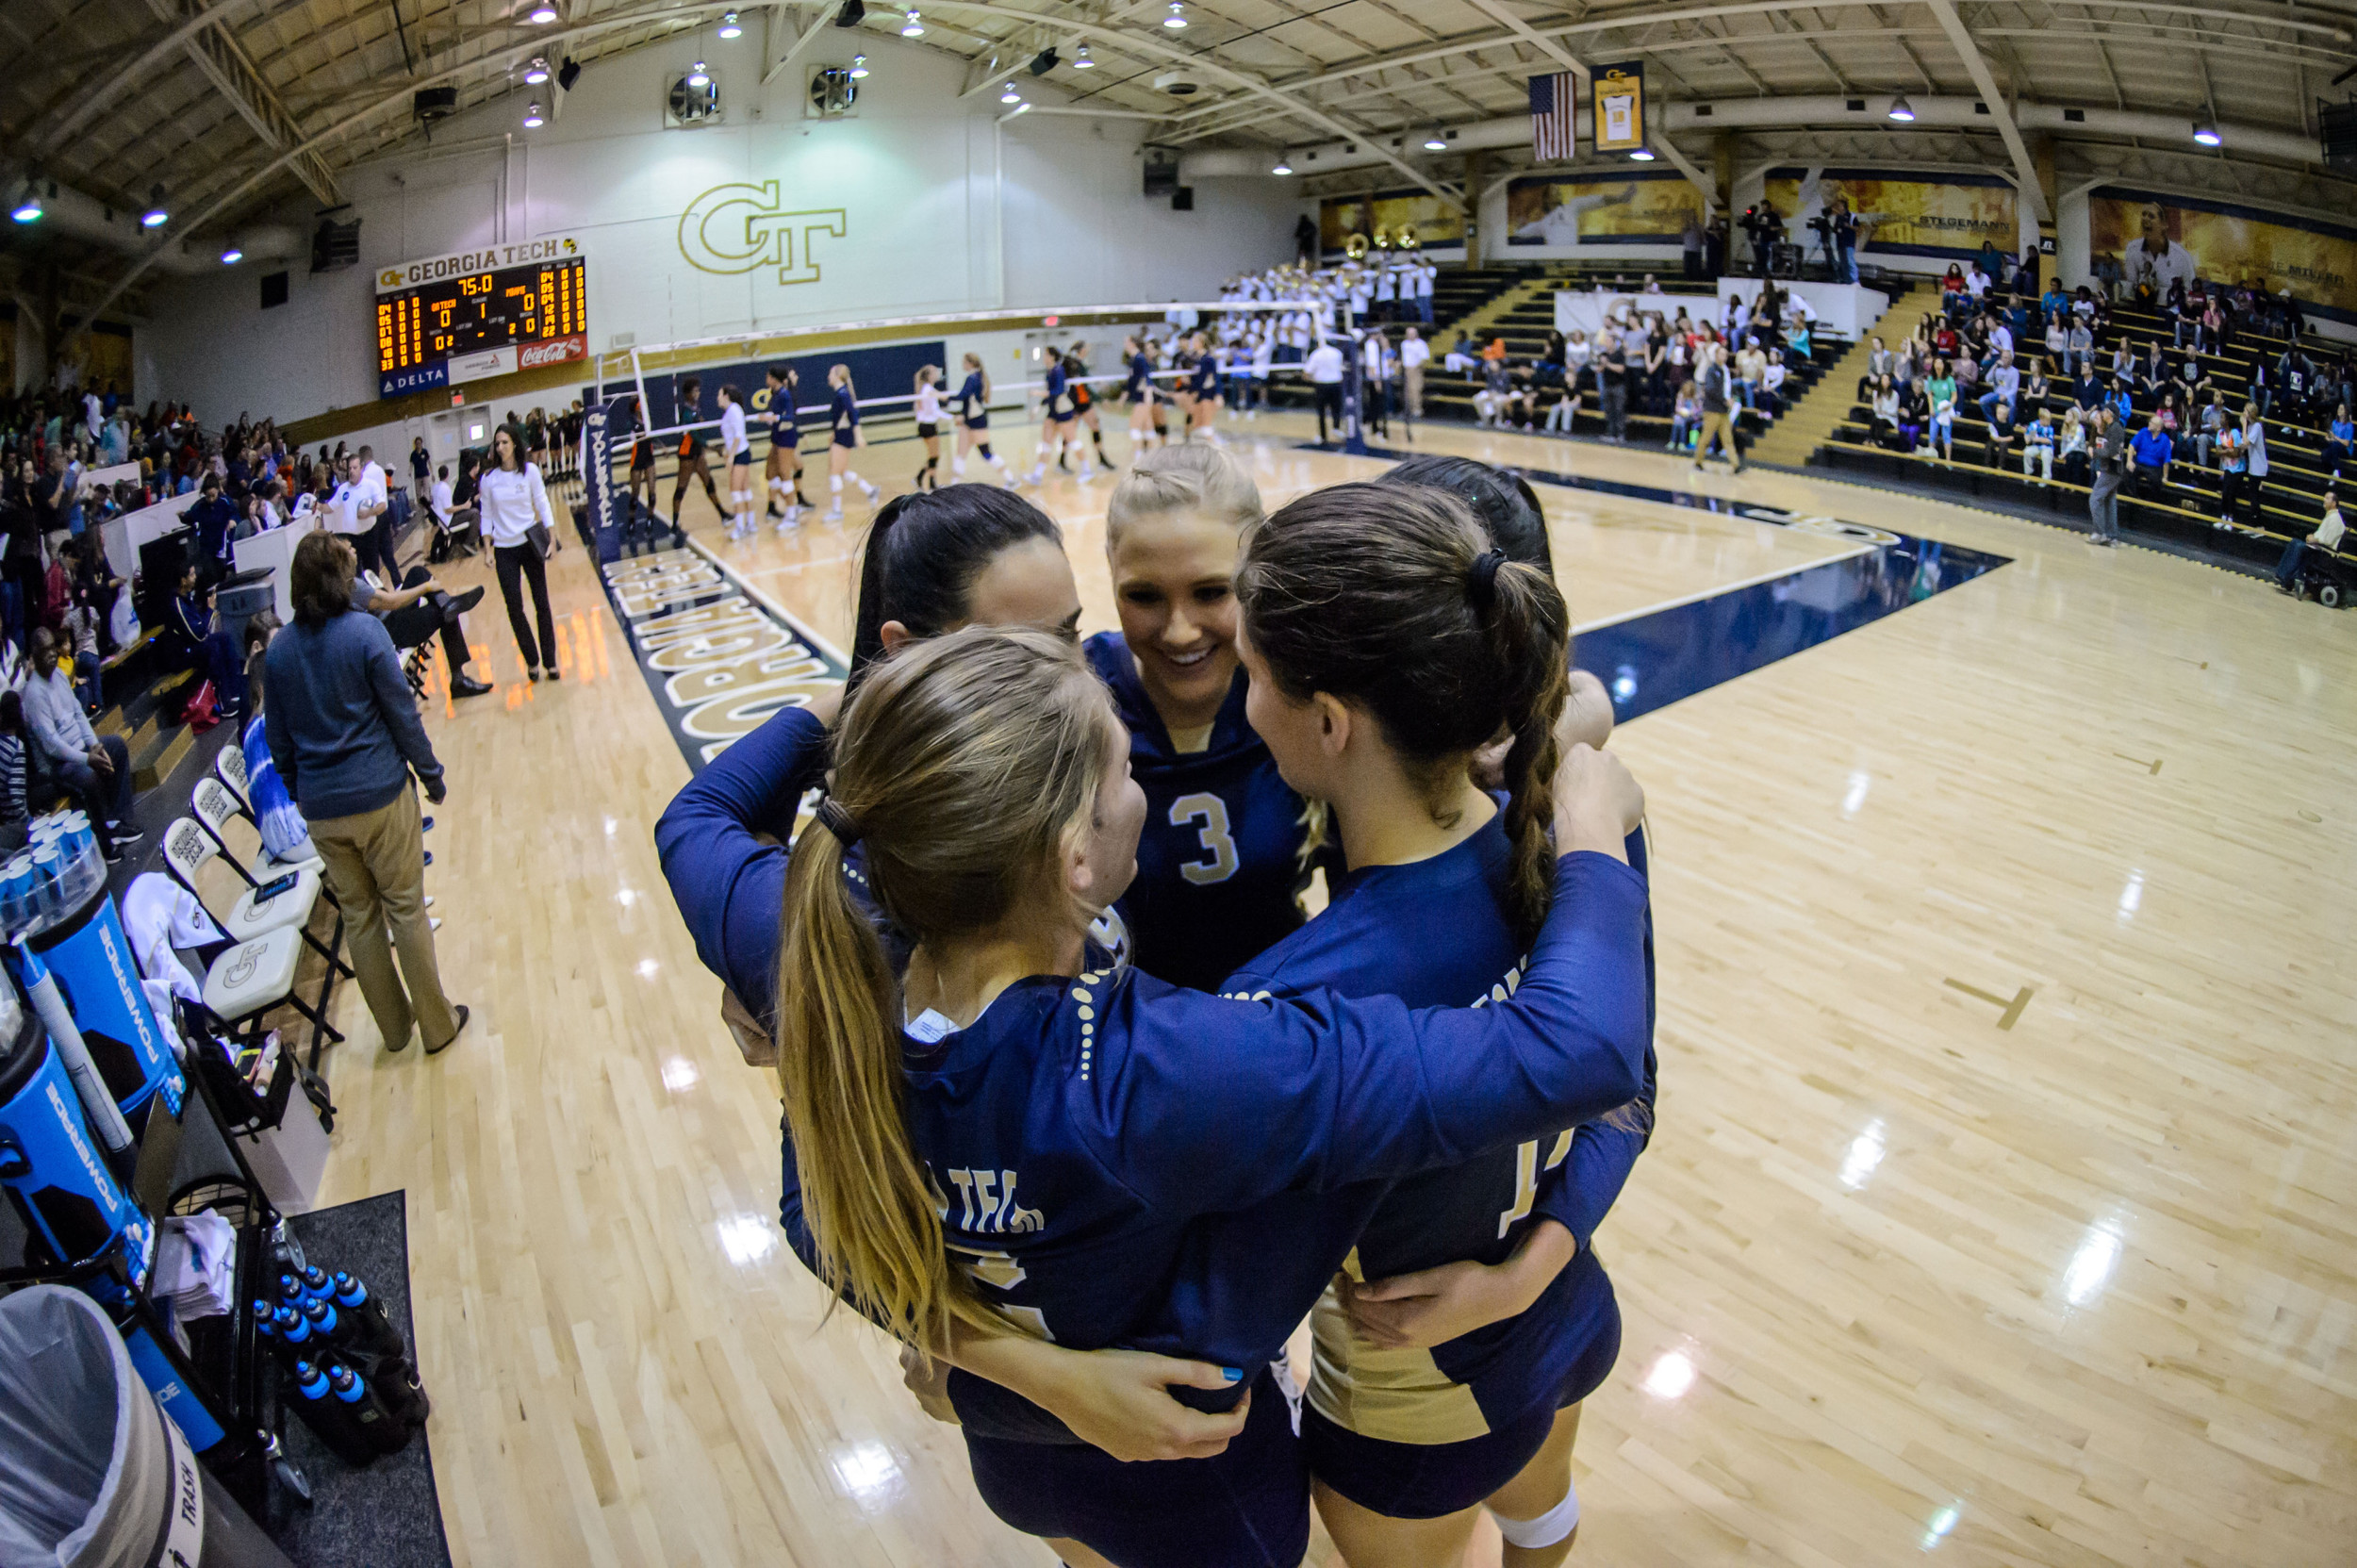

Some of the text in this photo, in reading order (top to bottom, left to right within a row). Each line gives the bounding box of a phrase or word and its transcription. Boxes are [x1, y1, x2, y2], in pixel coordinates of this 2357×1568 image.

[678, 179, 846, 285] GT
[408, 239, 557, 283] GEORGIA TECH
[458, 273, 492, 296] 75.0
[540, 267, 584, 283] 04 0 0
[540, 277, 584, 294] 05 0 0
[562, 290, 569, 301] 0
[576, 289, 584, 299] 0
[378, 304, 391, 315] 04
[398, 301, 405, 311] 0
[412, 297, 420, 307] 0
[524, 292, 535, 311] 0
[544, 304, 554, 315] 12
[562, 301, 569, 312] 0
[577, 299, 585, 309] 0
[379, 308, 420, 326] 05 0 0
[440, 309, 451, 328] 0
[562, 312, 569, 322] 0
[577, 309, 585, 321] 0
[379, 319, 420, 338] 07 0 0
[509, 318, 536, 335] 2 0
[542, 321, 585, 338] 22 0 0
[380, 337, 392, 349] 08
[400, 333, 406, 344] 0
[414, 330, 420, 340] 0
[436, 335, 453, 351] 0 2
[383, 341, 420, 358] 18 0 0
[381, 353, 421, 371] 33 0 0
[398, 369, 444, 388] DELTA
[633, 595, 847, 766] ORGIA
[1169, 792, 1240, 884] 3
[223, 943, 268, 988] GT
[99, 923, 159, 1065] POWERADE
[45, 1081, 118, 1213] POWERADE
[181, 1461, 196, 1528] TRASH
